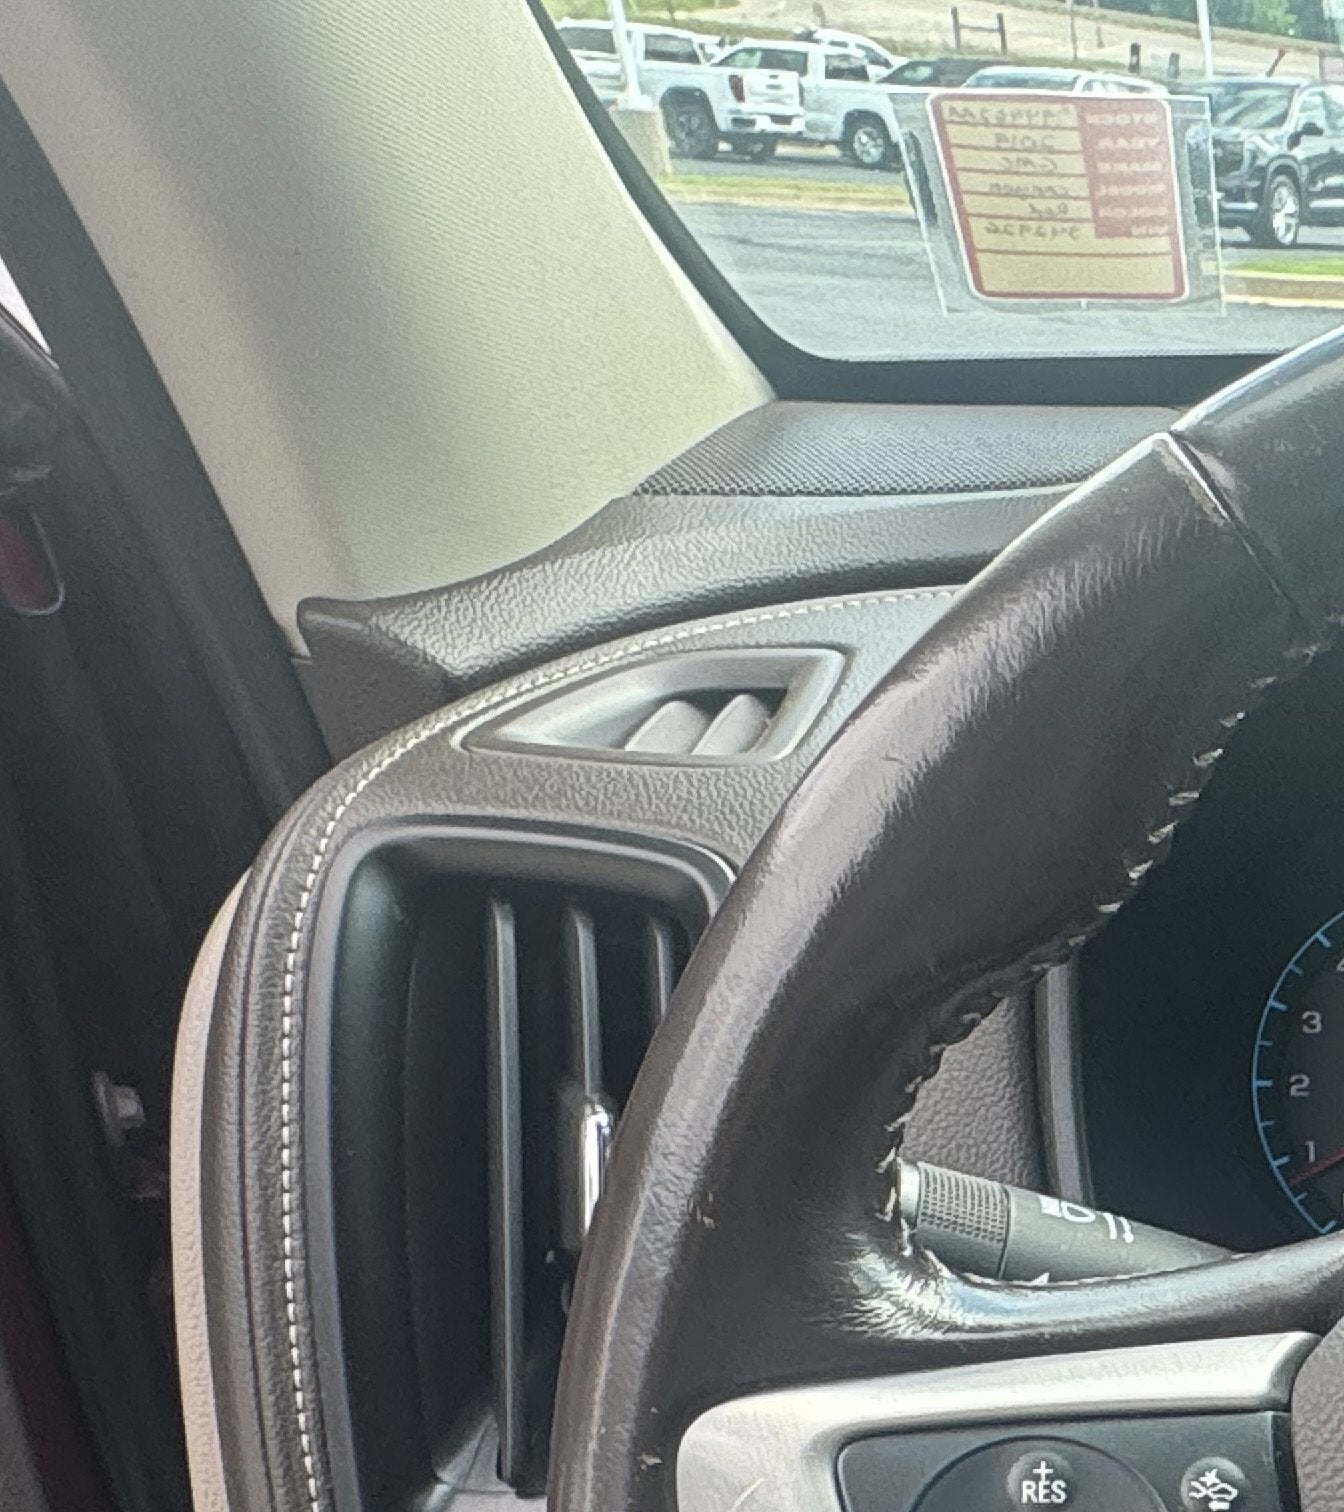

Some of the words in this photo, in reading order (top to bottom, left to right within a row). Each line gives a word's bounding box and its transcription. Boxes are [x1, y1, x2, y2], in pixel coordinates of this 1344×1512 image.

[1301, 1011, 1323, 1034] 3
[1289, 1074, 1311, 1096] 2
[1306, 1140, 1317, 1163] 1
[1021, 1480, 1067, 1504] RES
